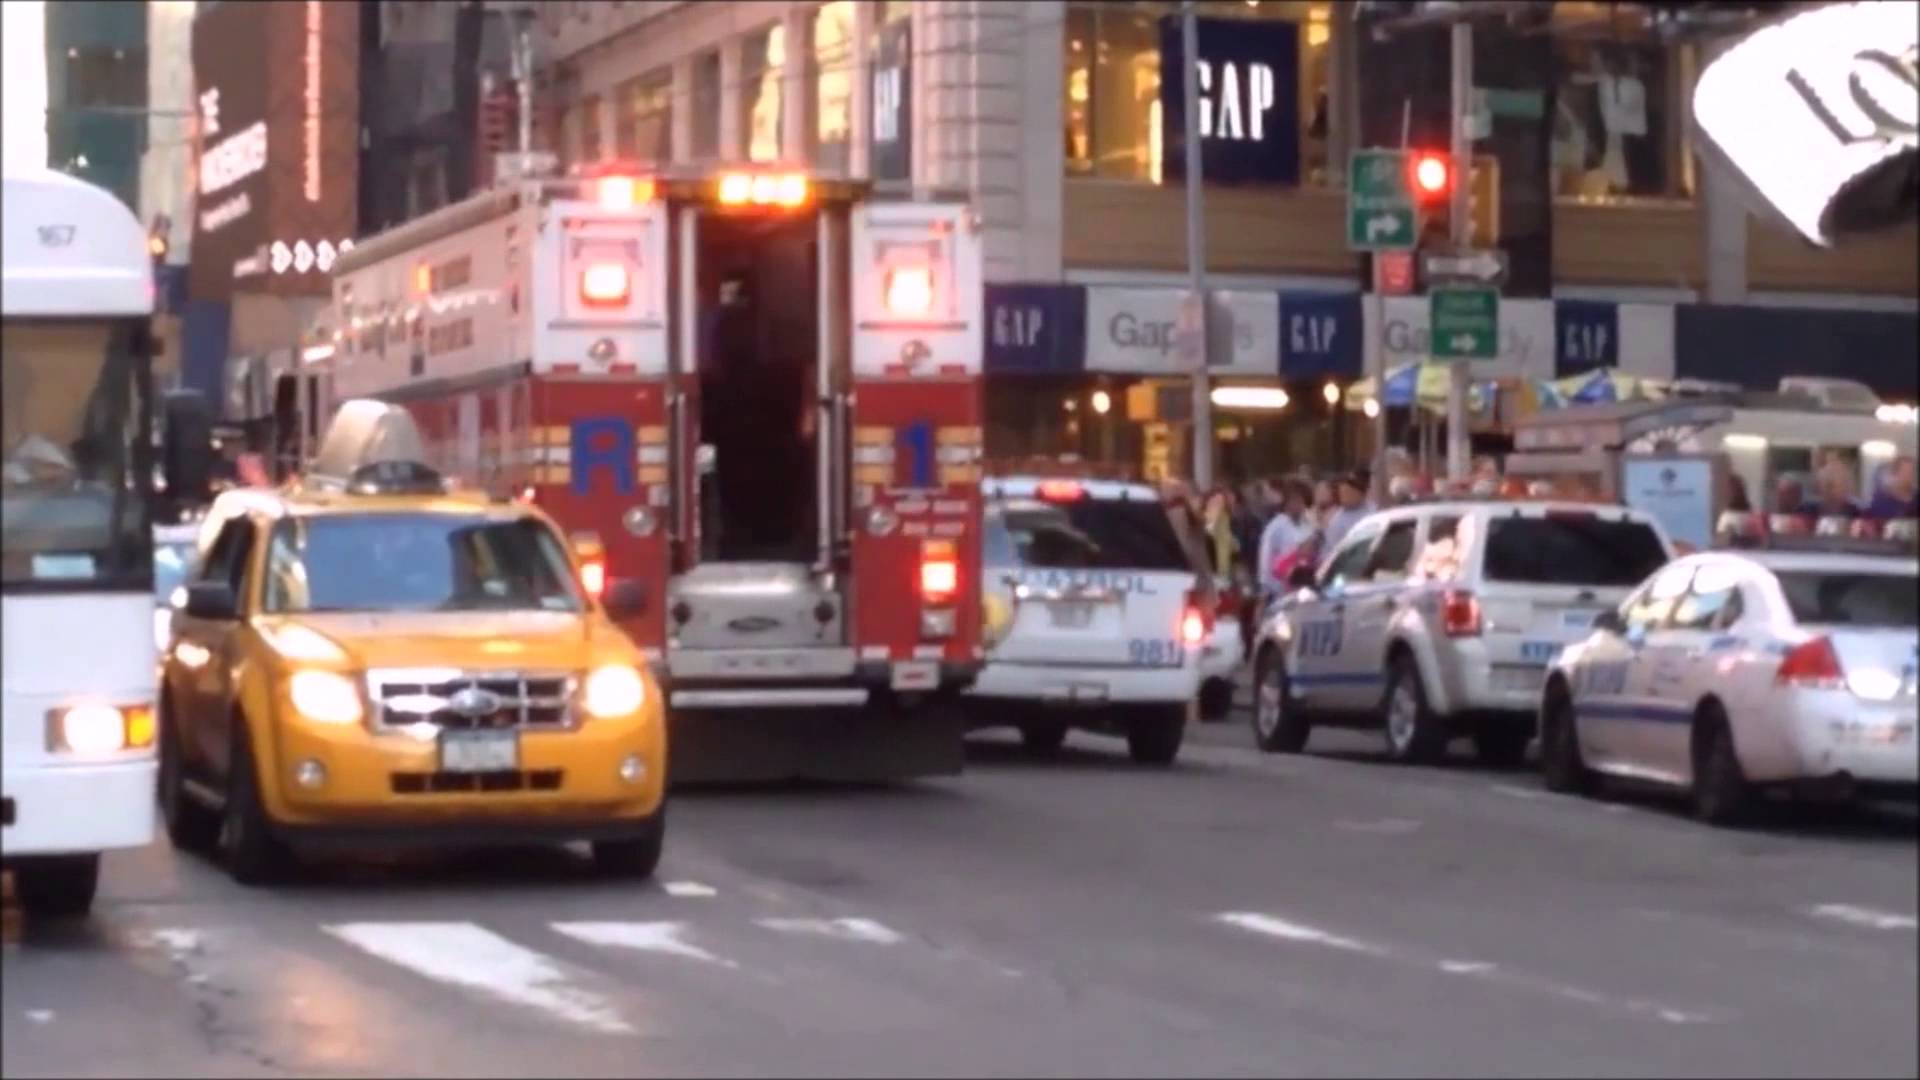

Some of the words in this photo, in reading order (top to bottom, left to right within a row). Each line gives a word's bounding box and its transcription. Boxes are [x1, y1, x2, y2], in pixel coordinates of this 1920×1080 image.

[37, 224, 77, 247] 167
[992, 306, 1042, 347] GAP
[1291, 315, 1337, 353] GAP
[1564, 322, 1609, 359] GAP
[905, 421, 935, 489] 1
